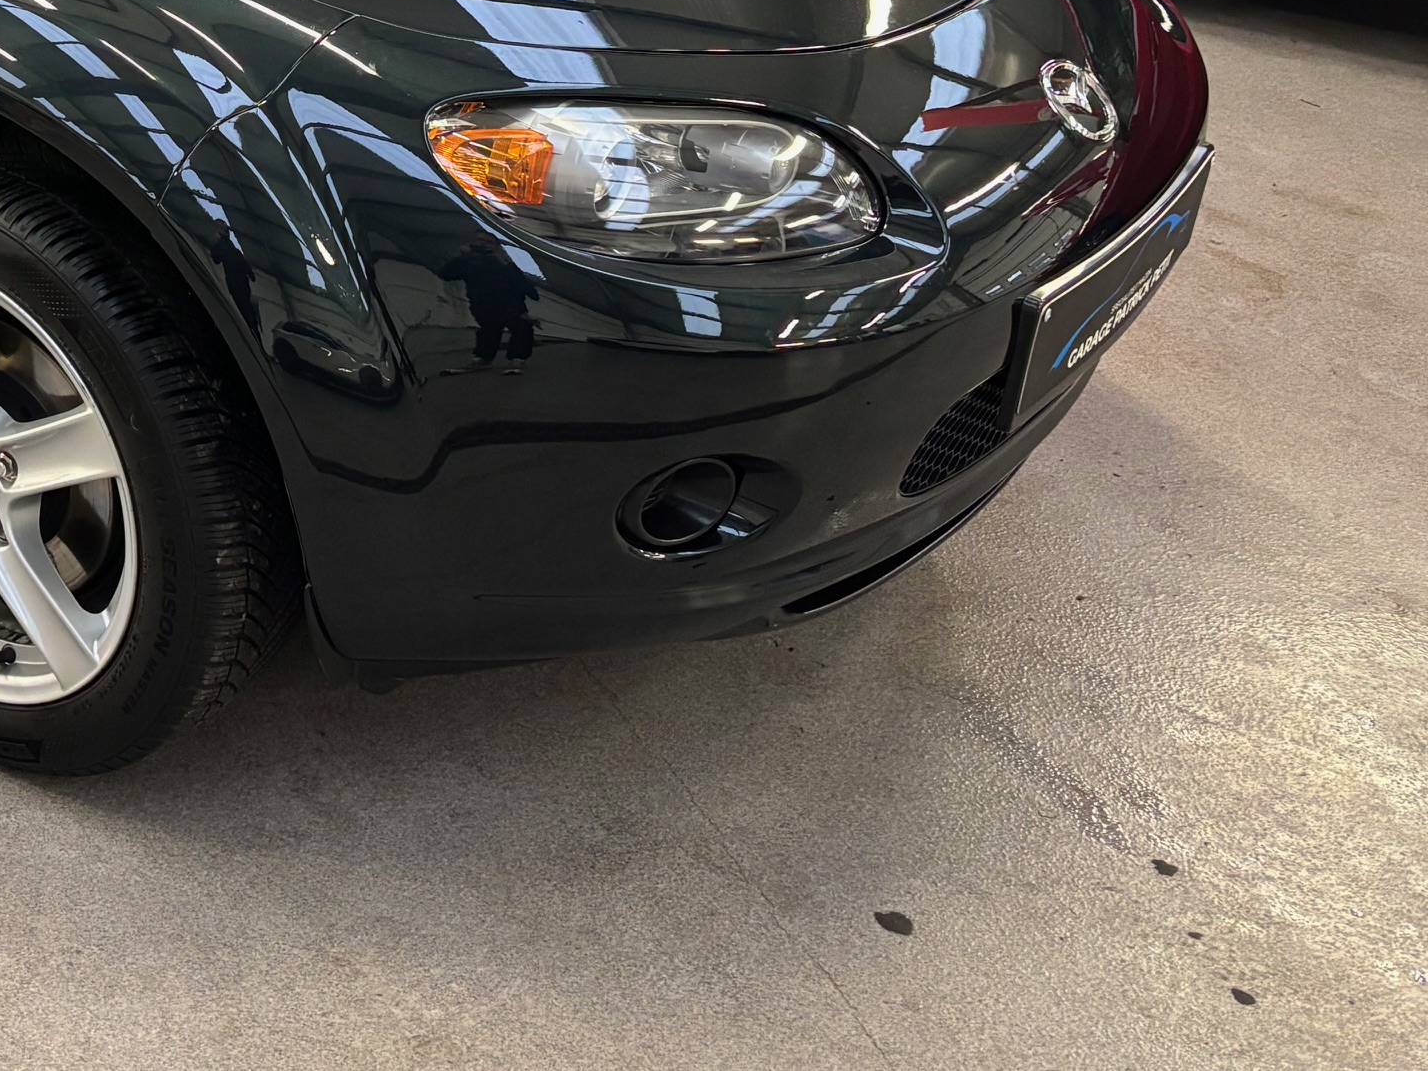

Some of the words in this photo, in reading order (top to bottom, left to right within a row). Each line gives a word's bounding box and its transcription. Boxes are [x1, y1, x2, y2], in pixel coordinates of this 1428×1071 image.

[1067, 315, 1114, 369] GARAGE
[1112, 275, 1153, 328] PATRICK
[154, 535, 179, 657] SEASON
[121, 660, 158, 715] MASTER
